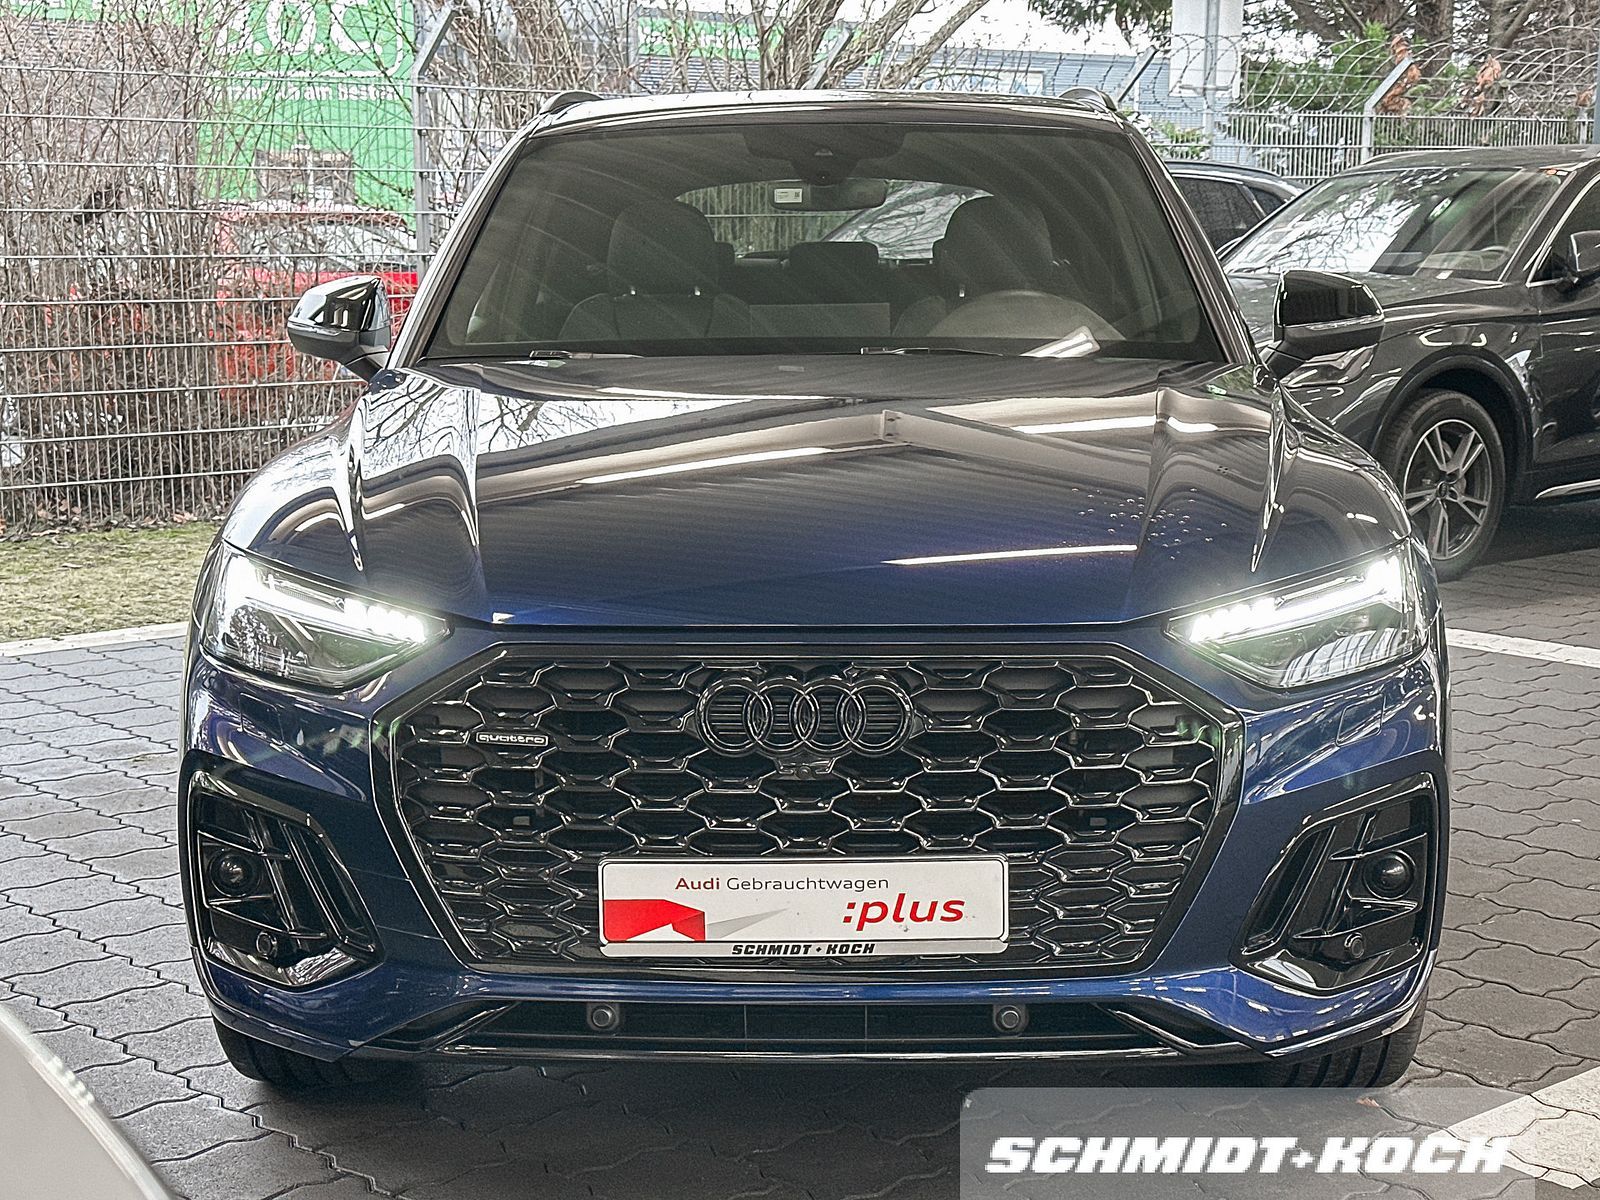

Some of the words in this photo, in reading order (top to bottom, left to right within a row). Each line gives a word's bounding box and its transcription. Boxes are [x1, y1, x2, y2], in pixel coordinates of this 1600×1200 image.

[479, 734, 545, 744] quattro
[675, 877, 720, 890] Audi
[726, 876, 889, 893] Gebrauchtwagen
[731, 944, 812, 955] SCHMIDT
[826, 943, 875, 954] KOCH
